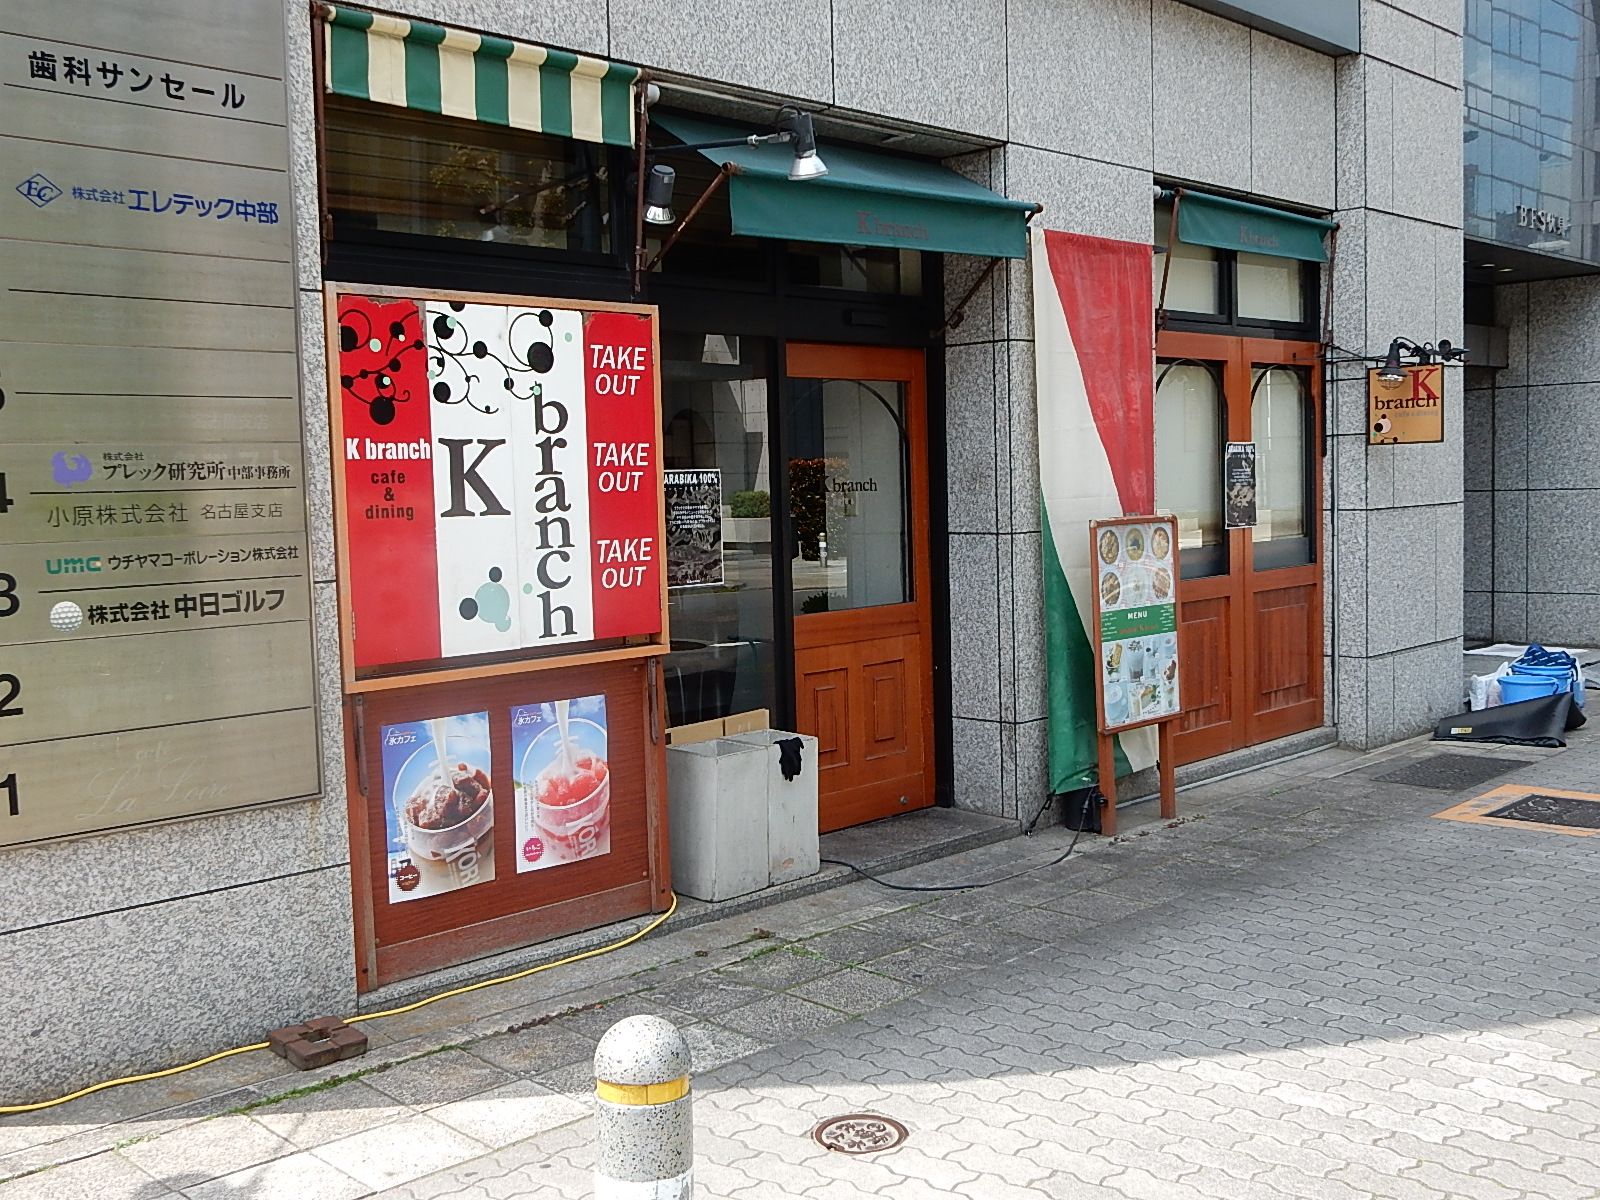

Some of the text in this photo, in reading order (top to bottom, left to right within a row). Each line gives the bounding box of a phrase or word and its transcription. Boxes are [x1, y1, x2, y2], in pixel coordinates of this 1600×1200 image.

[28, 50, 246, 110] 歯科サンセール
[128, 188, 280, 225] エレテック中部
[590, 344, 647, 371] TAKE
[595, 373, 641, 396] OUT
[1408, 367, 1440, 401] K
[1374, 395, 1438, 411] branch
[102, 452, 145, 462] 株式会社
[346, 438, 431, 461] K branch
[593, 442, 650, 467] TAKE
[103, 461, 291, 481] プレック研究所 中部事務所
[370, 469, 406, 485] cafe
[598, 471, 644, 493] OUT
[664, 472, 718, 485] ARABIKA 100%
[383, 486, 395, 502] &
[833, 478, 878, 493] branch
[47, 502, 283, 528] 小原株式会社 名古屋支店
[364, 504, 414, 521] dining
[437, 380, 579, 639] K branch
[596, 537, 653, 564] TAKE
[601, 566, 647, 589] OUT
[87, 589, 285, 626] 株式会社 中日ゴルフ
[1127, 611, 1148, 620] MENU
[0, 673, 24, 718] 2
[0, 773, 19, 817] 1
